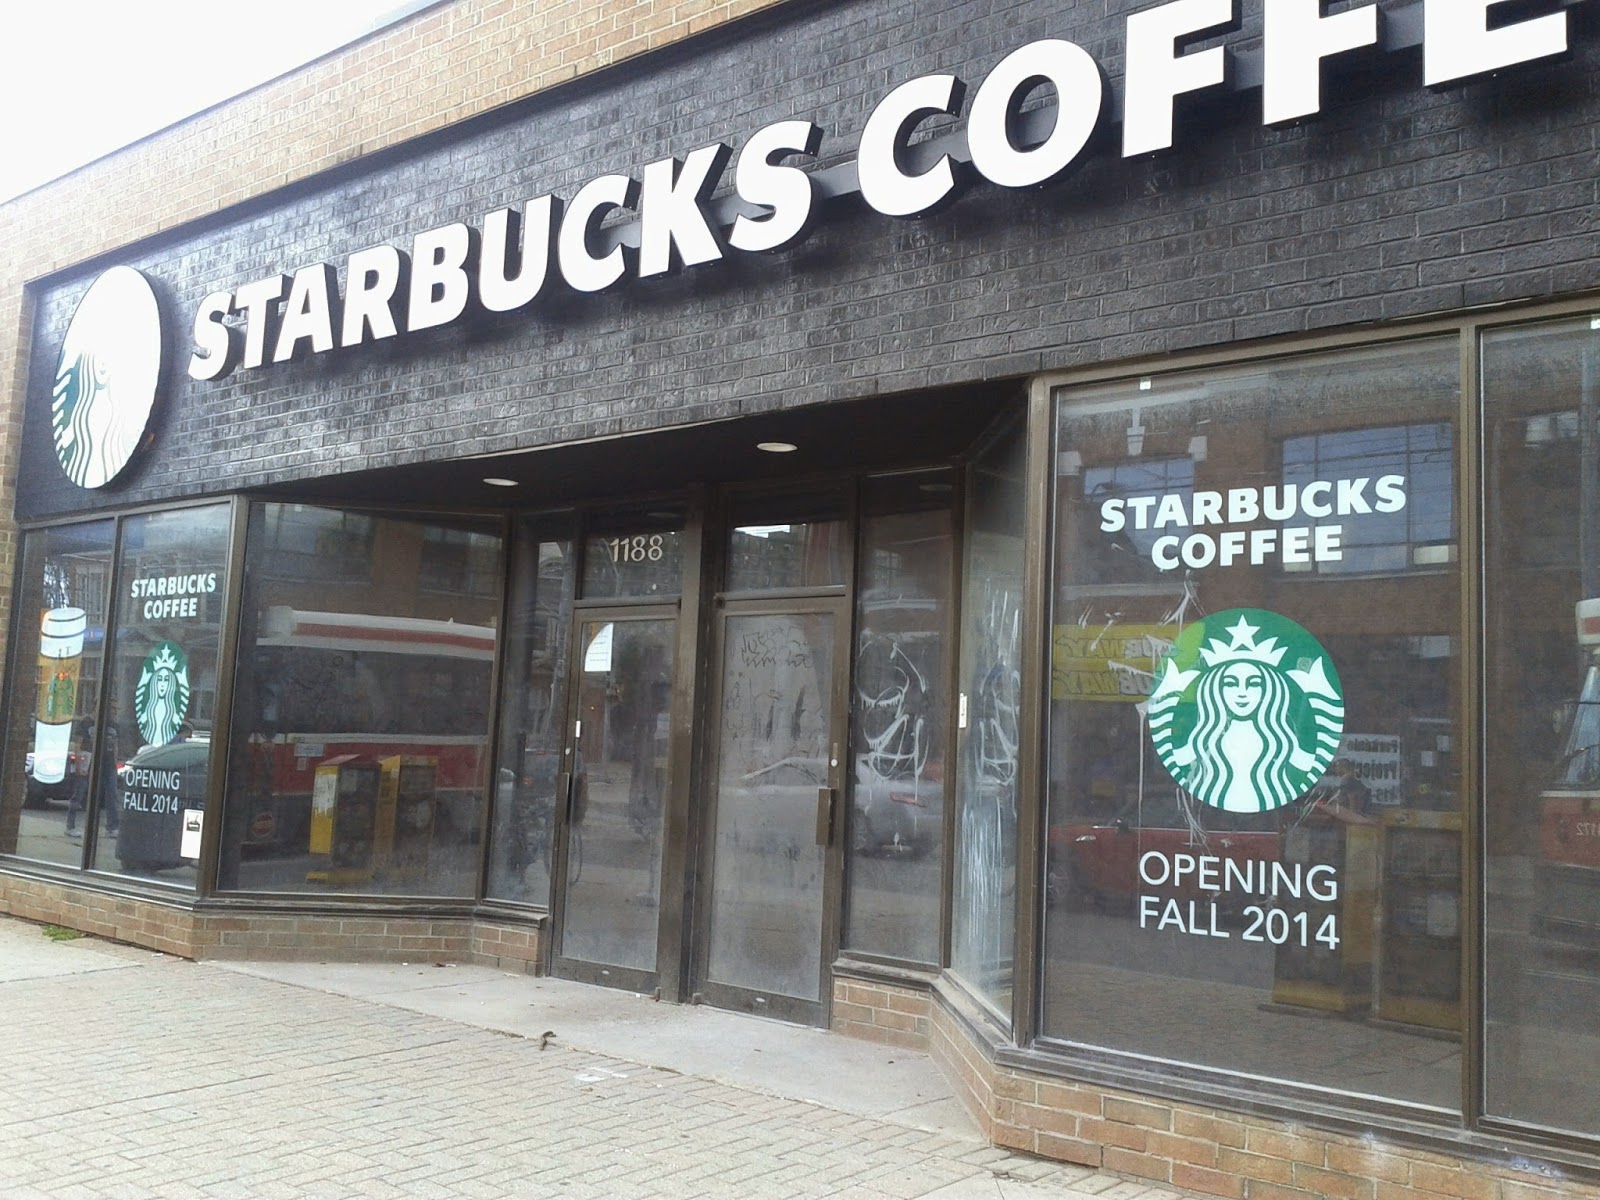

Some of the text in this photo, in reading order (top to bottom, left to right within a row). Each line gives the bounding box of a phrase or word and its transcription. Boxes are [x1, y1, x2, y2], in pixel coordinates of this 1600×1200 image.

[188, 120, 819, 381] STARBUCKS
[1100, 474, 1406, 533] STARBUCKS
[609, 535, 664, 563] 1188
[1151, 524, 1343, 571] COFFEE
[130, 572, 217, 599] STARBUCKS
[143, 598, 198, 620] COFFEE
[125, 767, 181, 791] OPENING
[122, 791, 150, 811] FALL
[150, 793, 179, 815] 2014
[1138, 850, 1338, 902] OPENING
[1139, 896, 1341, 951] FALL 2014
